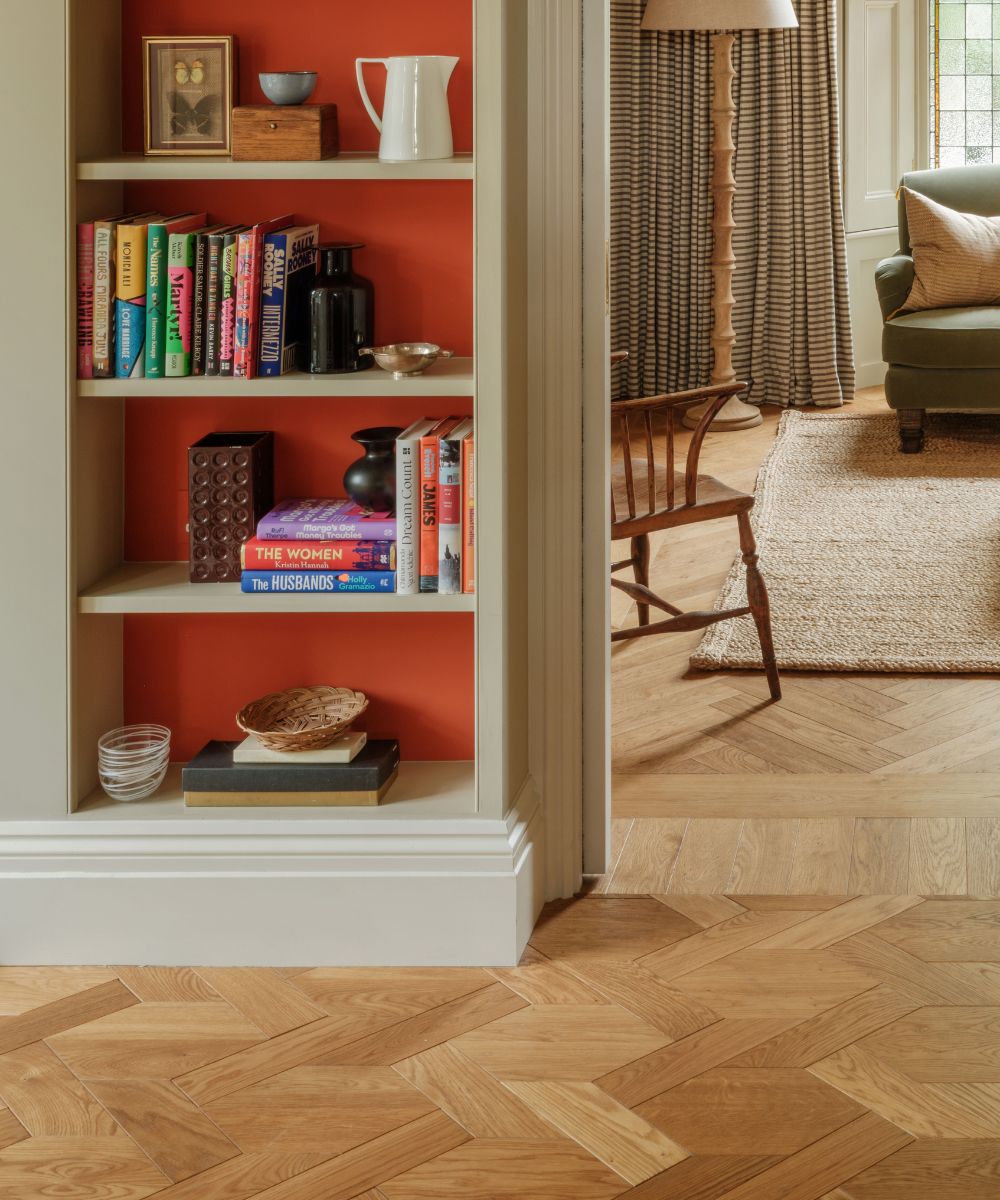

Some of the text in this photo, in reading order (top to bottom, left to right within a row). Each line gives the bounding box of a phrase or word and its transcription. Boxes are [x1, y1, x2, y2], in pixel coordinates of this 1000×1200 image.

[150, 249, 161, 286] Names
[263, 244, 274, 296] ROONEY
[274, 249, 284, 290] SALLY
[96, 232, 108, 356] ALL FOURS MIRANDA JULY
[122, 242, 131, 358] MONICA ALI LOVE MARRIAGE
[166, 274, 184, 340] Martyr!
[209, 285, 216, 293] TO
[261, 305, 281, 361] INTERMEZZO
[402, 460, 412, 499] Count
[402, 503, 412, 544] Dream
[423, 484, 436, 526] JAMES
[296, 532, 324, 540] Money
[304, 524, 337, 532] Margo's
[256, 548, 342, 560] THE WOMEN
[252, 575, 334, 590] The HUSBANDS
[347, 576, 367, 584] Holly
